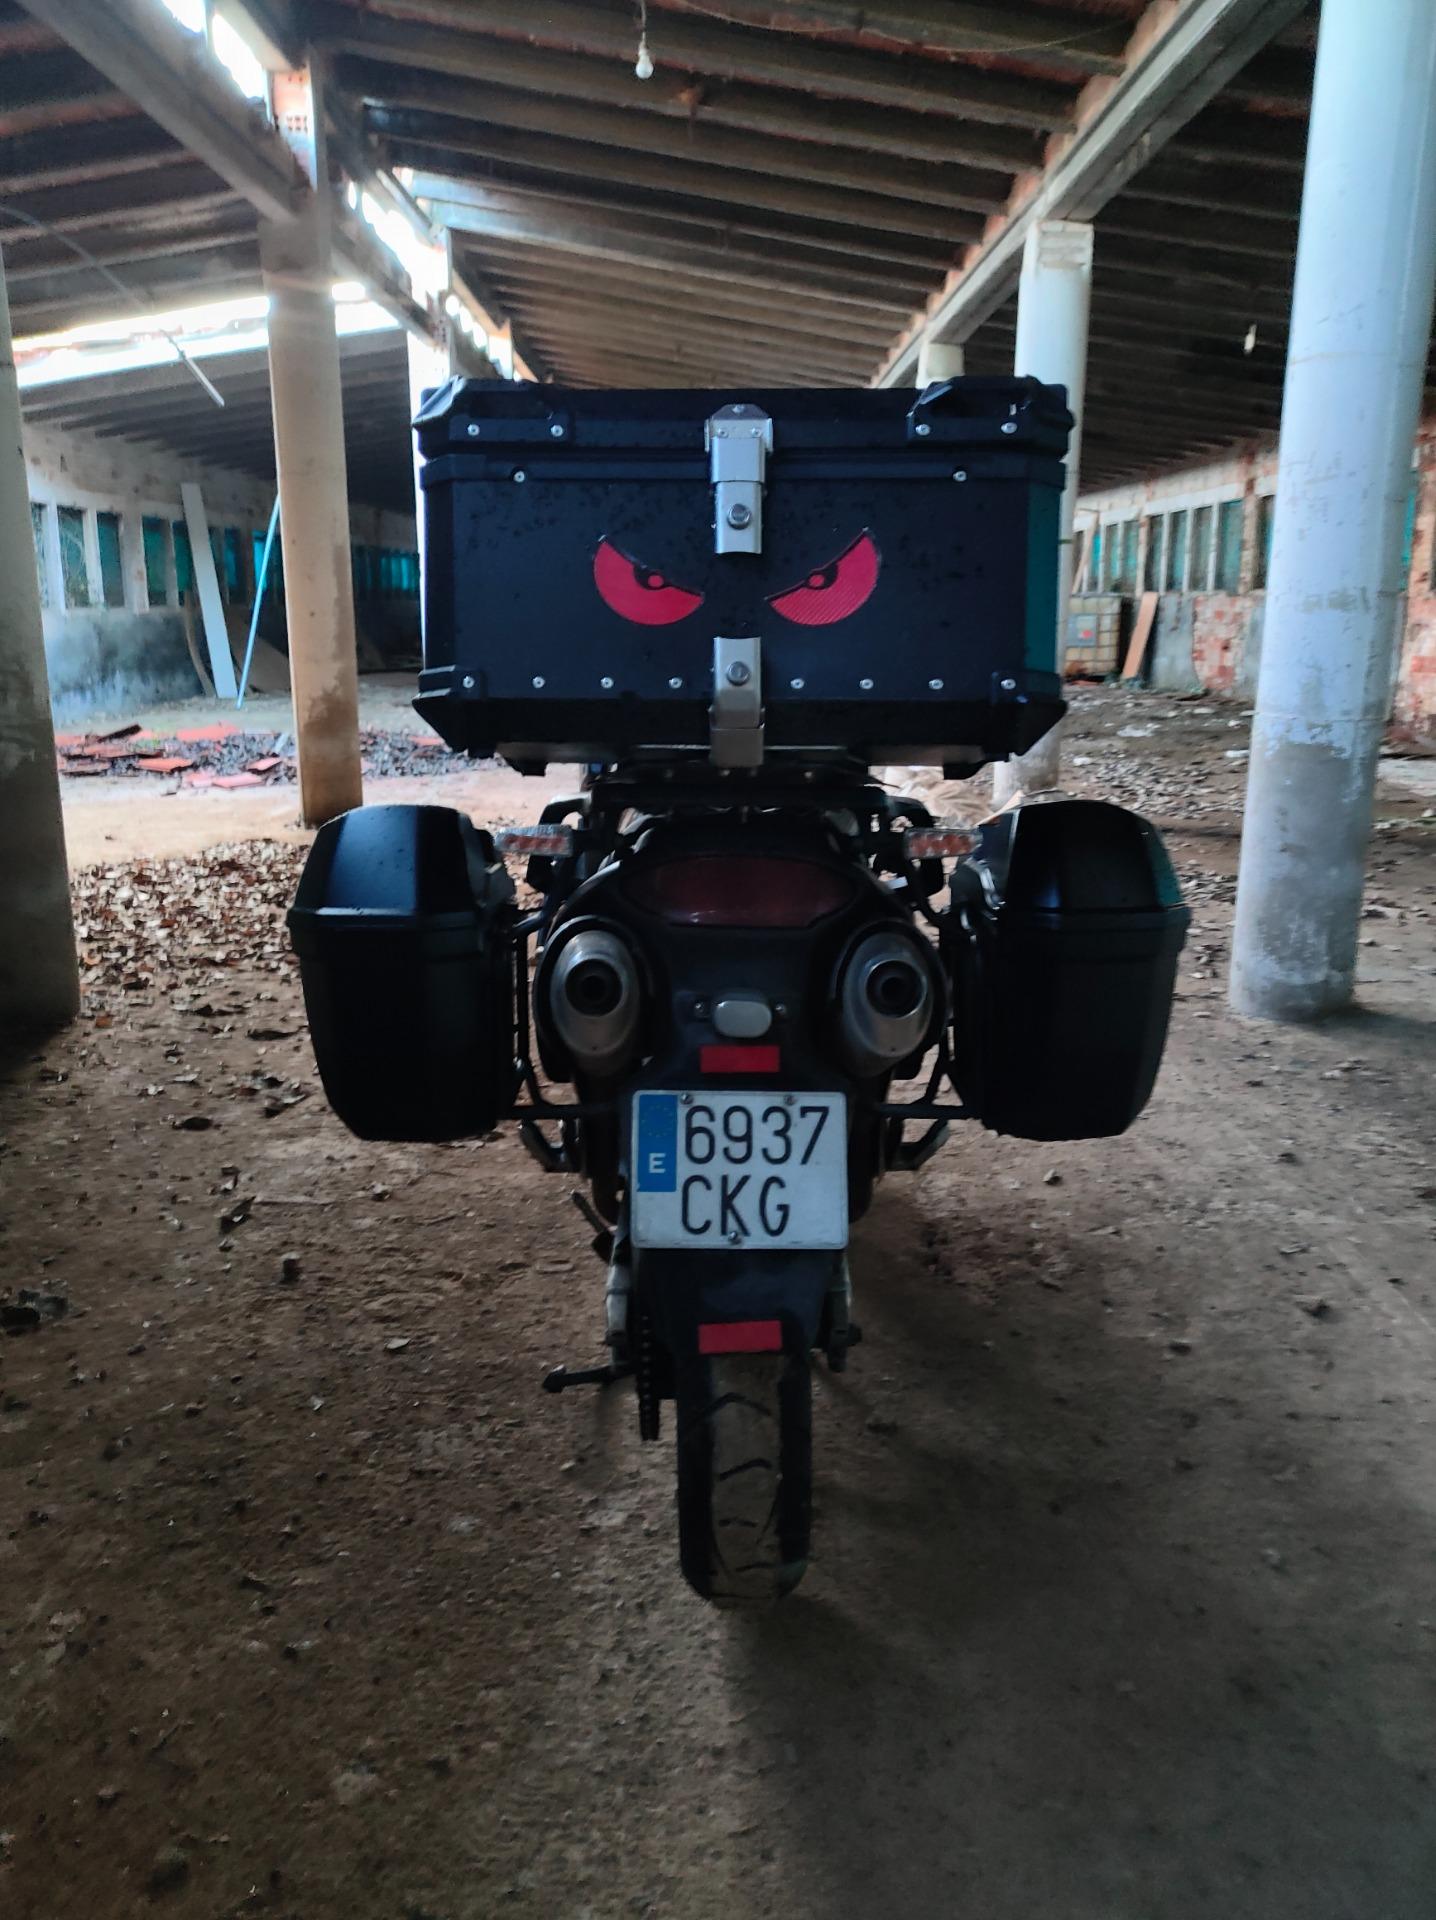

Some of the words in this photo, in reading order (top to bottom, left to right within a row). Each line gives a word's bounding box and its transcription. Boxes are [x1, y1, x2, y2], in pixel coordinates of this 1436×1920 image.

[649, 1153, 666, 1174] E
[685, 1105, 830, 1165] 6937
[681, 1174, 790, 1237] CKG
